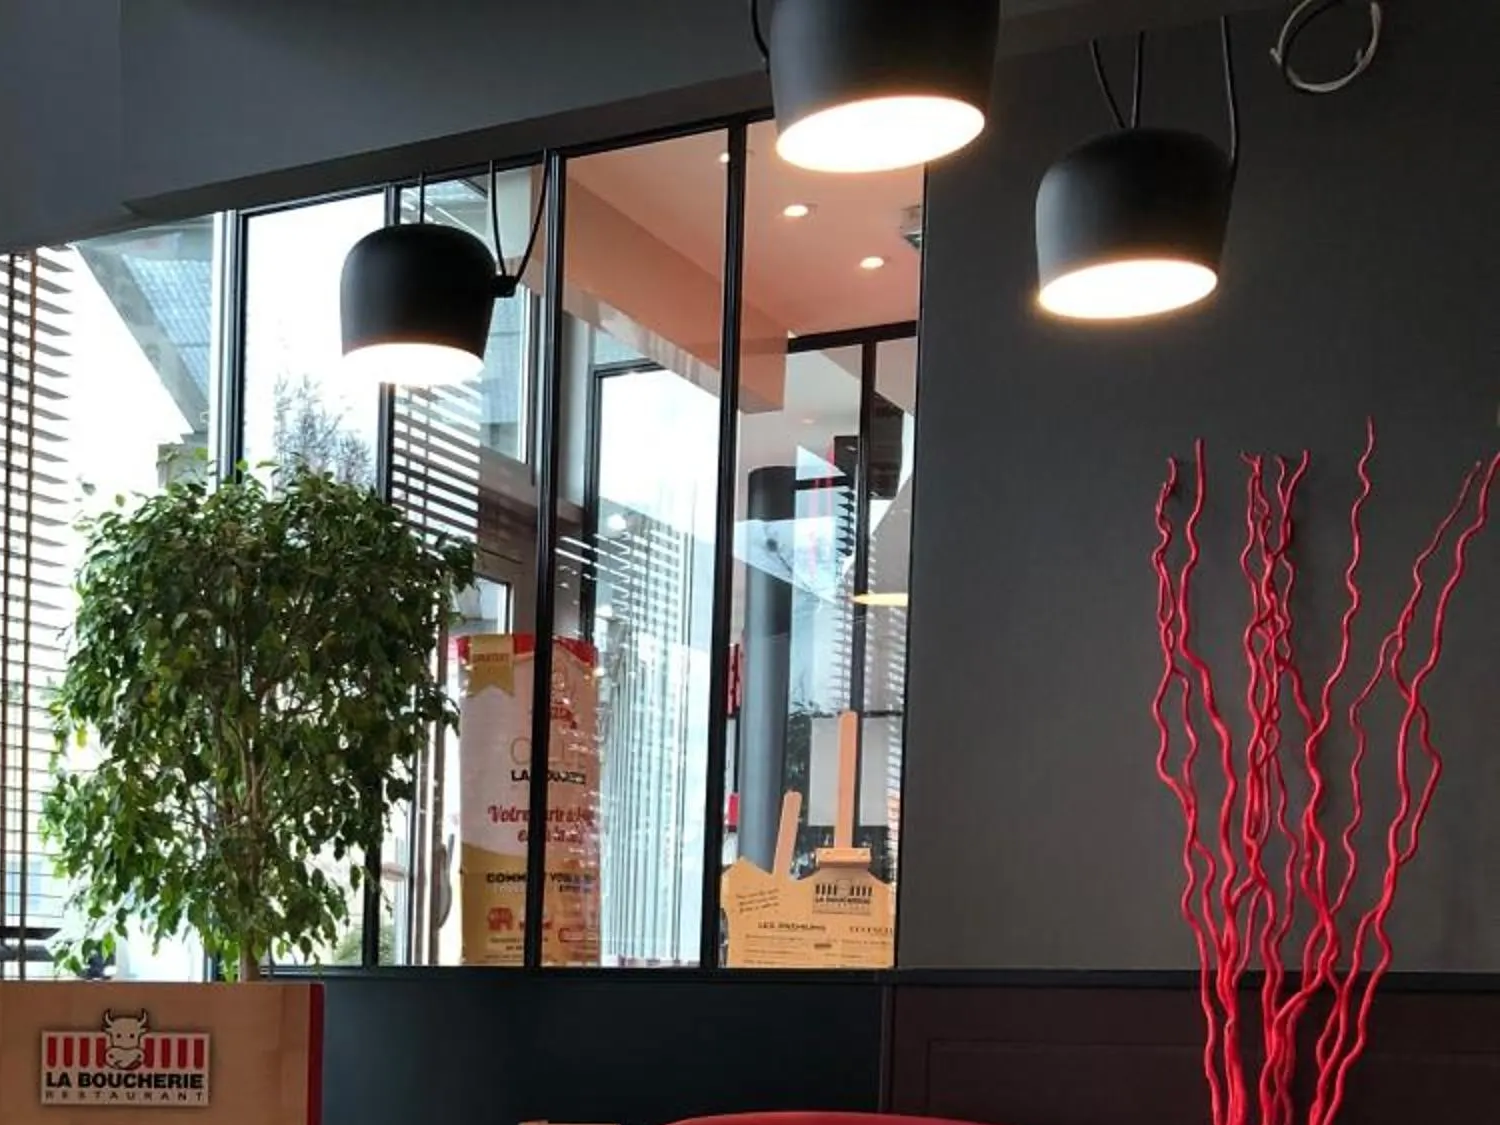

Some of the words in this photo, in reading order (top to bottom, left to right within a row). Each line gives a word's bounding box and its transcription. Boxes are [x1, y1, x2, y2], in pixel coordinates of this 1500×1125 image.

[46, 1072, 72, 1089] LA
[78, 1072, 204, 1089] BOUCHERIE
[46, 1091, 204, 1101] RESTAURANT
